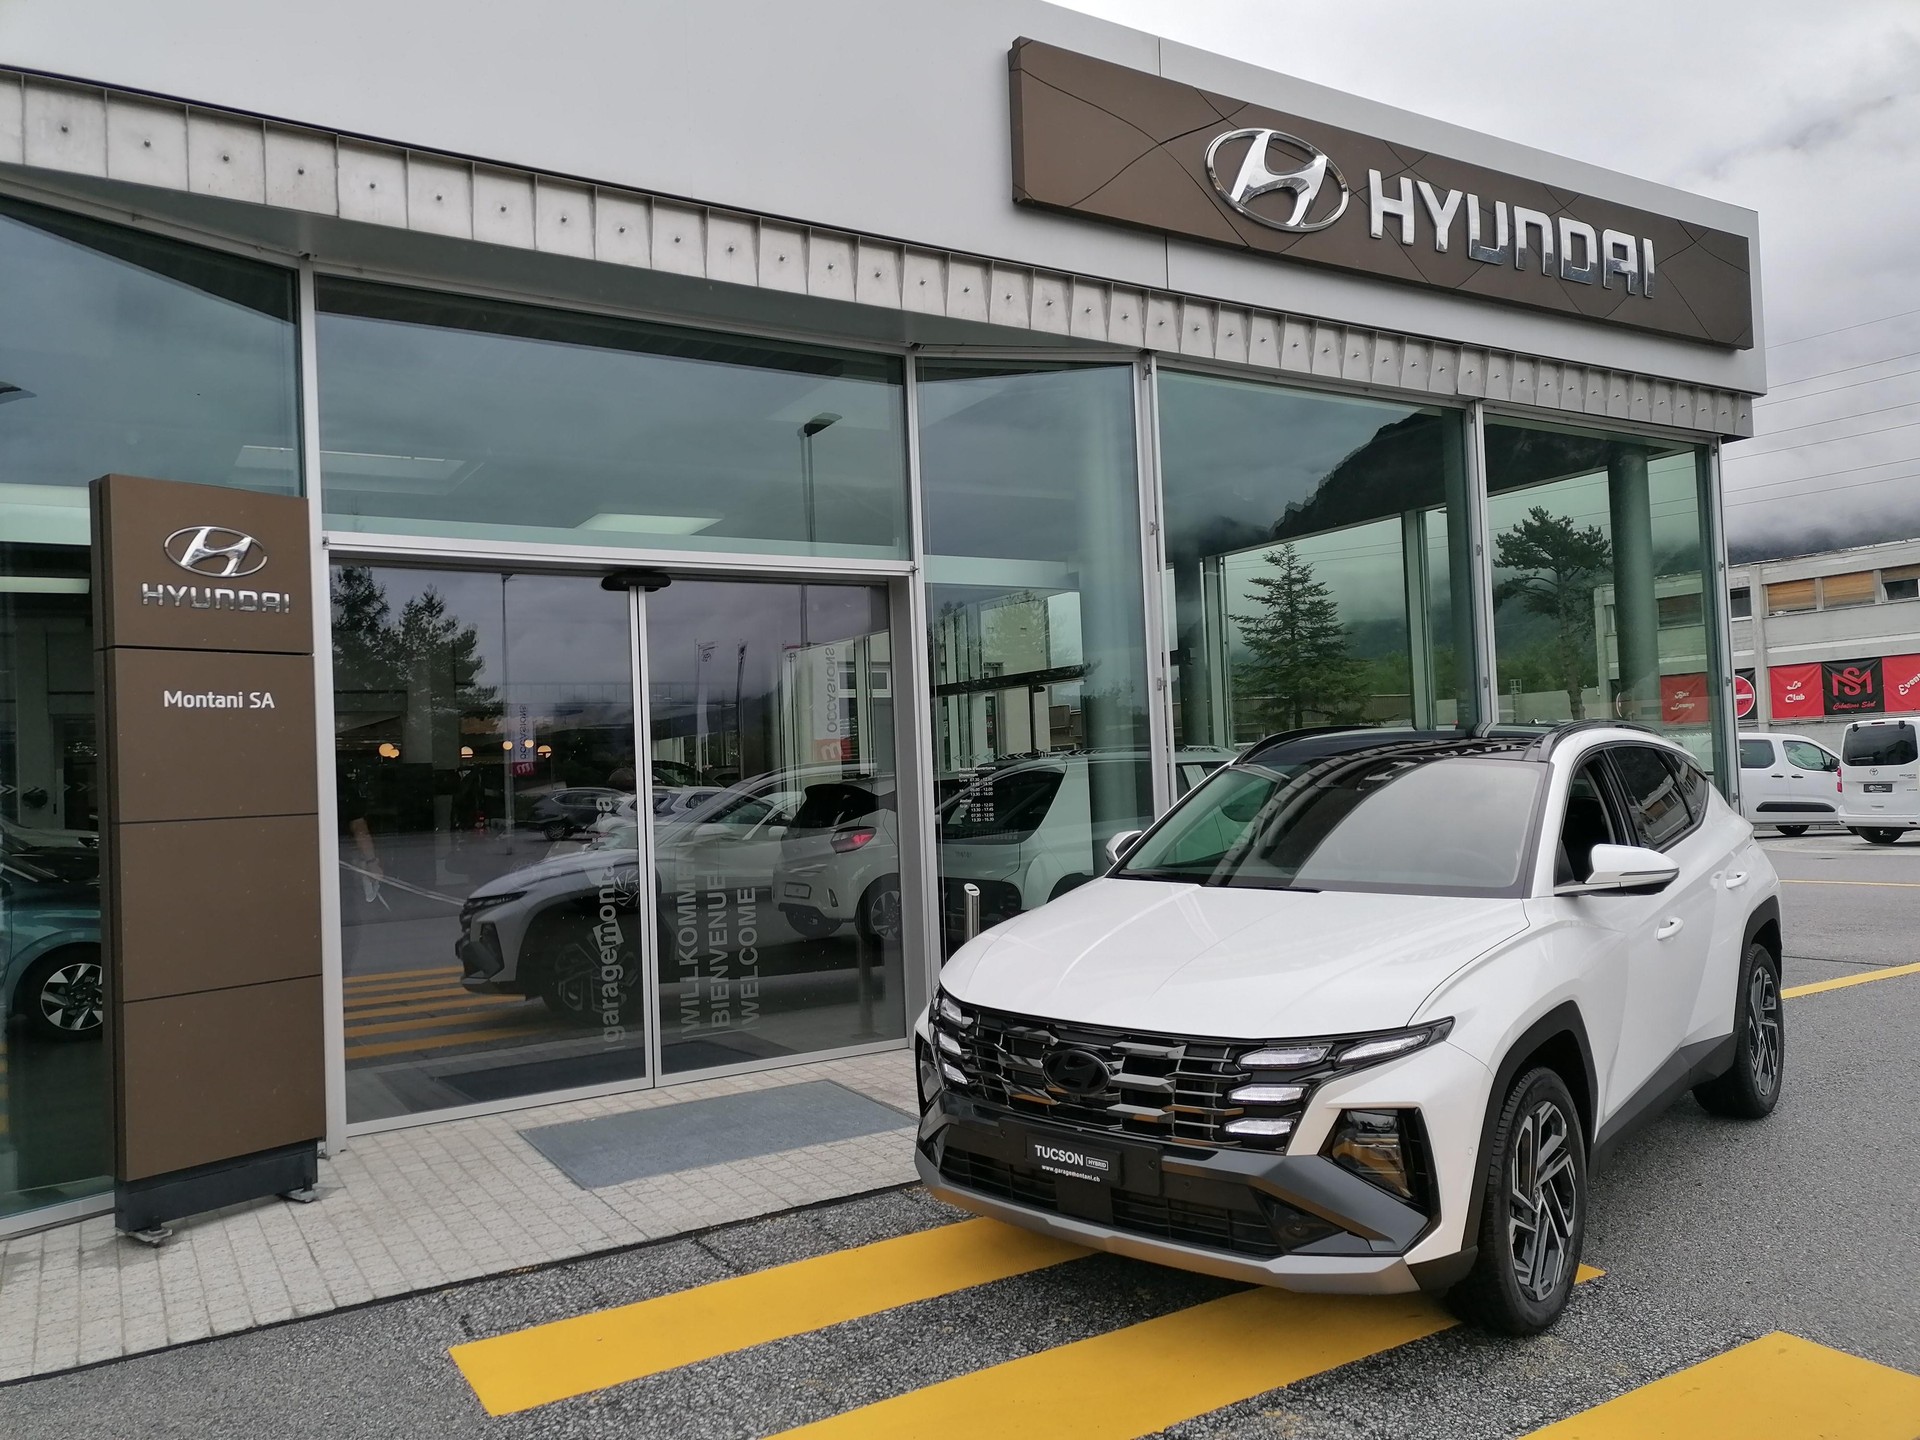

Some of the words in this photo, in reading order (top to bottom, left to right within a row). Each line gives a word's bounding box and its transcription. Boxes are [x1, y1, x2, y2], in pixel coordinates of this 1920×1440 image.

[1368, 168, 1656, 299] HYUNDAI
[141, 583, 290, 613] HYUNDAI
[164, 690, 243, 708] Montani
[249, 692, 275, 709] SA
[1785, 692, 1806, 703] Club
[707, 874, 731, 1028] BIENVENUE
[737, 888, 760, 1025] WELCOME
[1035, 1144, 1084, 1166] TUCSON
